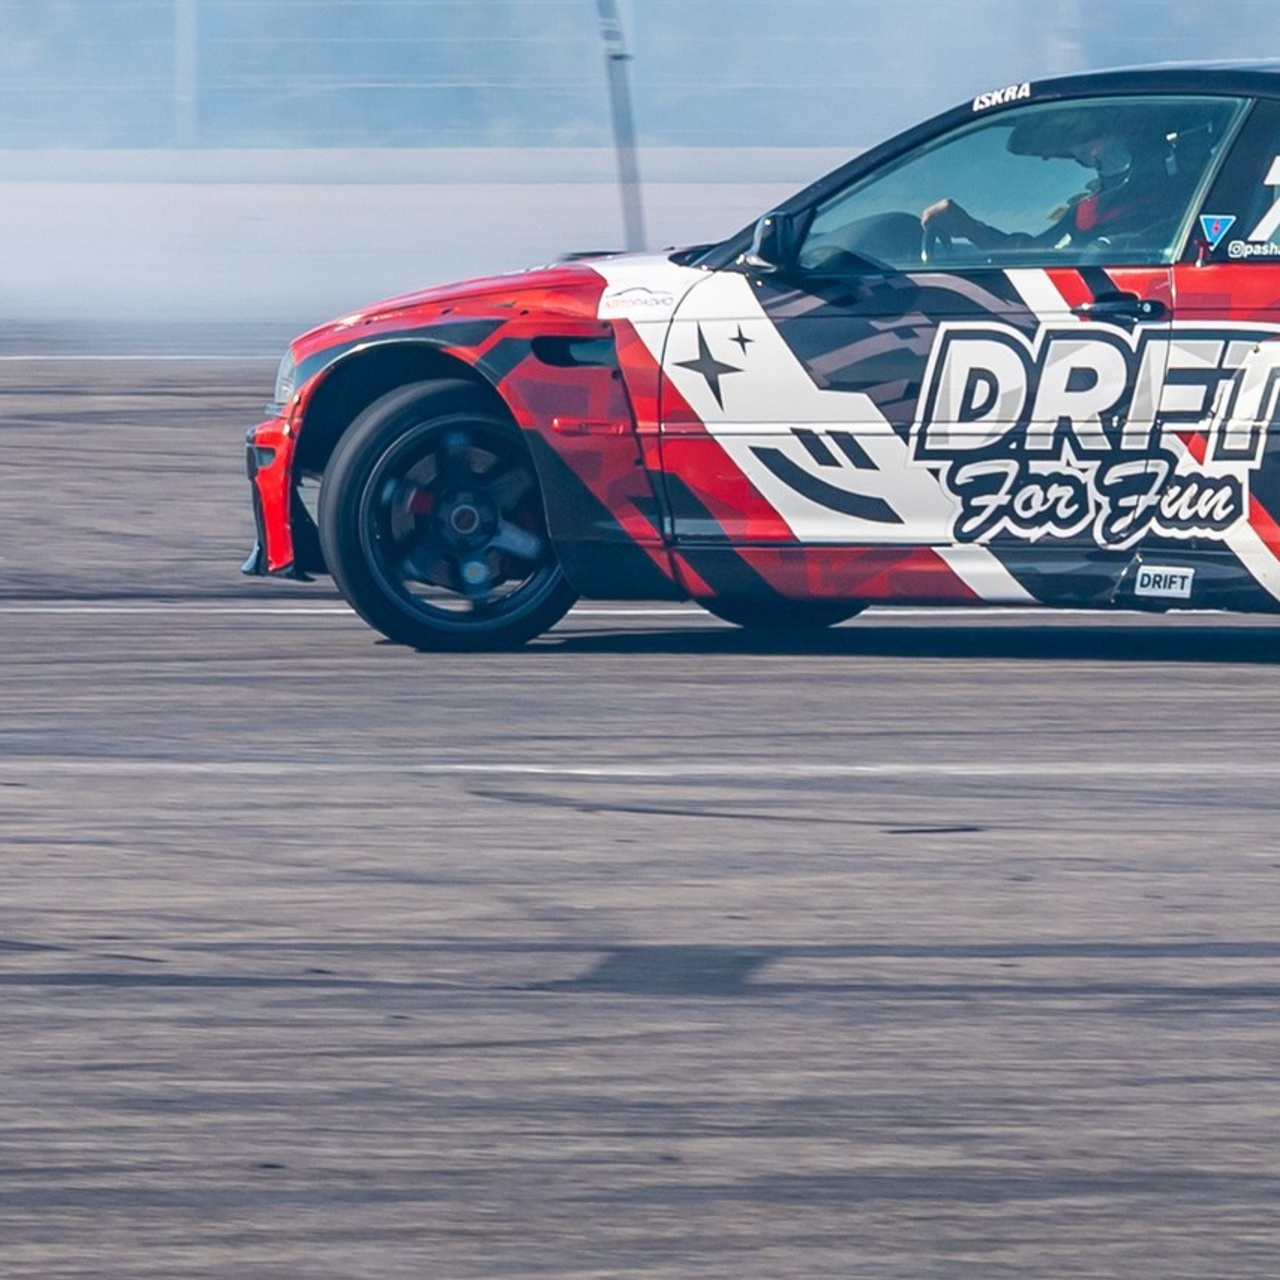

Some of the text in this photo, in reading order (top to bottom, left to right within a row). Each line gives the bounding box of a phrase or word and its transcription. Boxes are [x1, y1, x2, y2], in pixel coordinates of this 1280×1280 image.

[973, 82, 1031, 112] ISKRA
[954, 459, 1236, 533] For Fun
[1140, 573, 1189, 590] DRIFT
